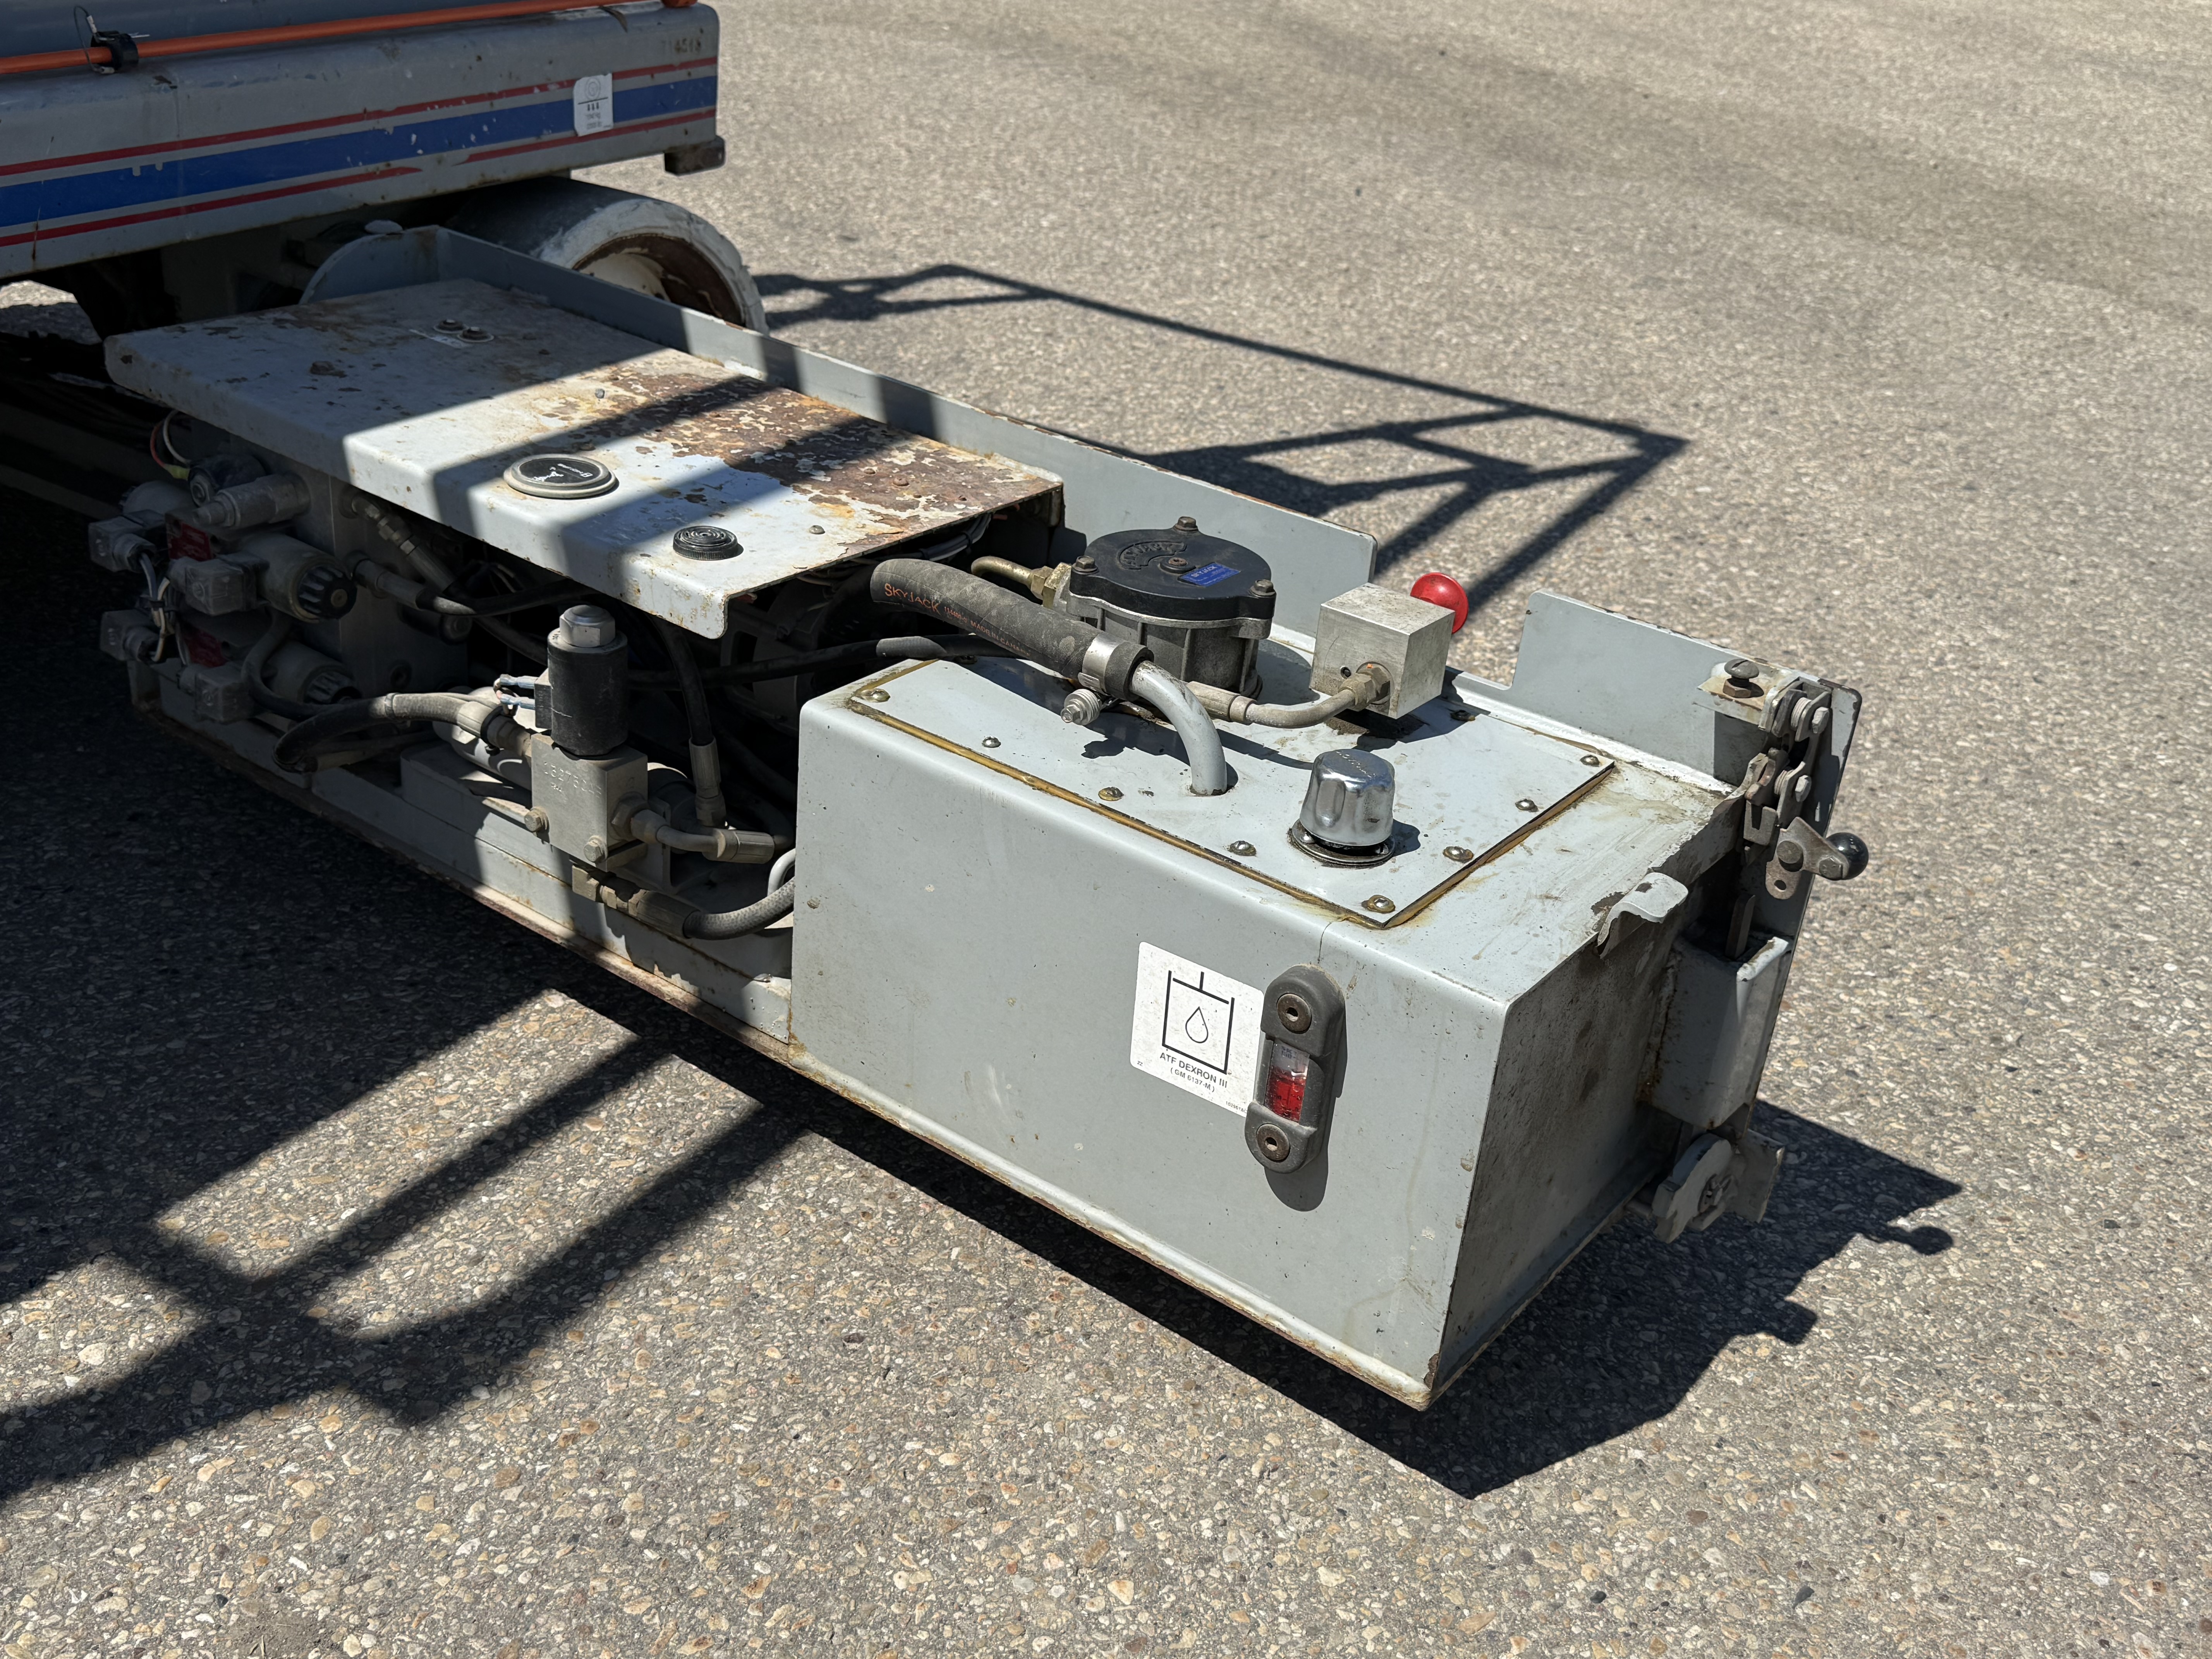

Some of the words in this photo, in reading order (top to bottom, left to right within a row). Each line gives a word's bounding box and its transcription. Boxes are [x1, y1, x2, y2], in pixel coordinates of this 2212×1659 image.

[884, 583, 942, 617] SKYJACK
[970, 620, 991, 637] MADE
[1160, 1052, 1176, 1064] ATF
[1179, 1060, 1216, 1083] DEXRON
